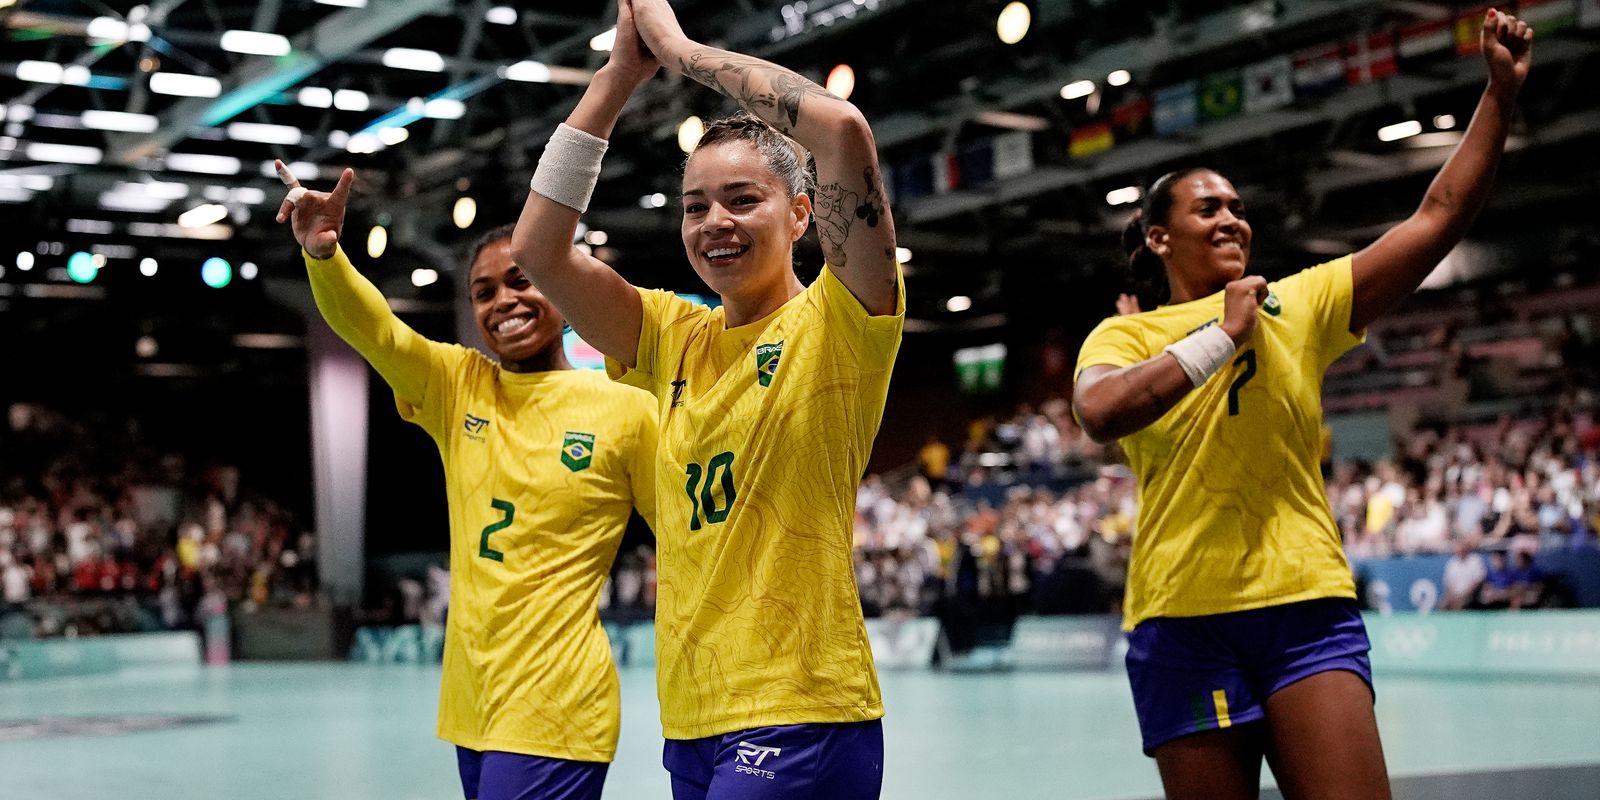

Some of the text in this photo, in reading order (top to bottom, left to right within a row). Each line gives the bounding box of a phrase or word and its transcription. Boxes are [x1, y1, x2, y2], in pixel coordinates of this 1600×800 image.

[1228, 349, 1257, 416] 7
[685, 451, 737, 531] 10
[479, 498, 515, 563] 2
[735, 741, 782, 767] RT
[735, 765, 776, 780] SPORTS
